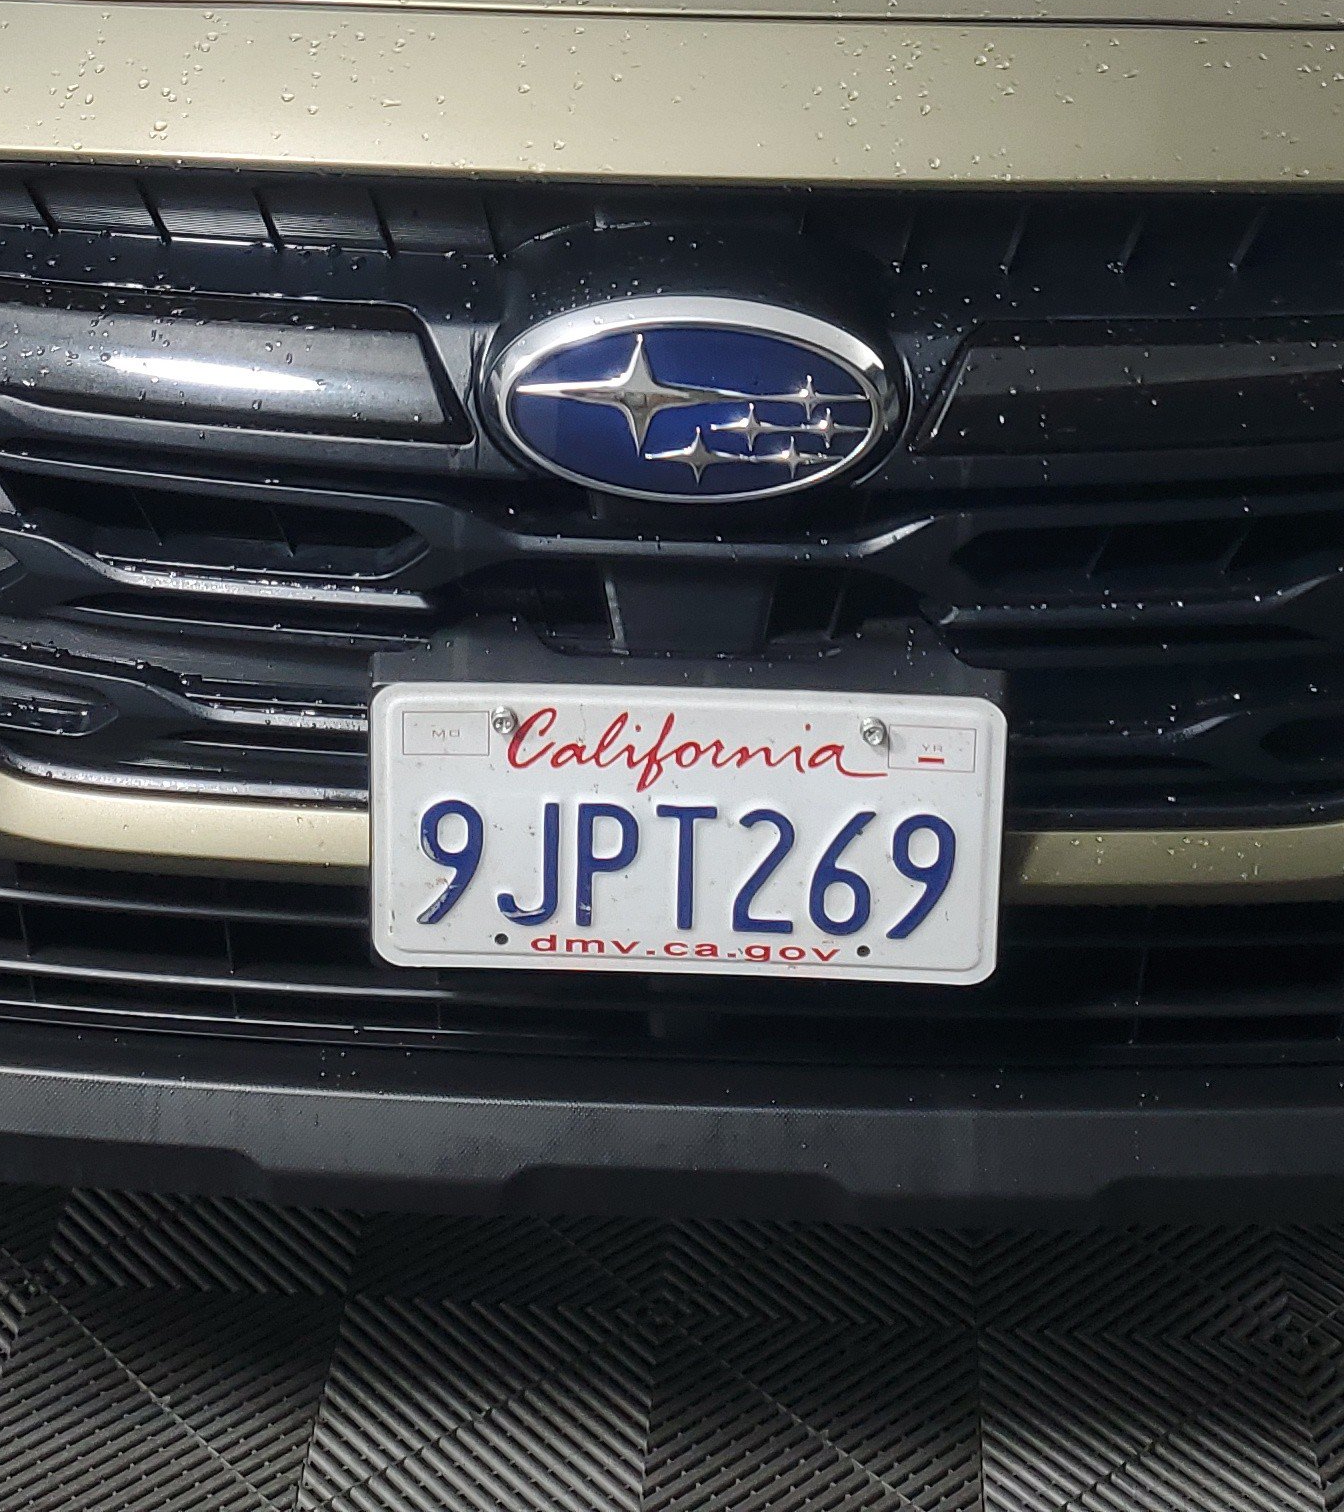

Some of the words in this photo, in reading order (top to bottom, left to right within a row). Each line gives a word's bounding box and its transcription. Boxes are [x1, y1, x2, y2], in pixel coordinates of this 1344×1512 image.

[507, 707, 888, 792] California
[416, 800, 956, 940] 9JPT269
[530, 933, 840, 963] dmv.ca.gov
